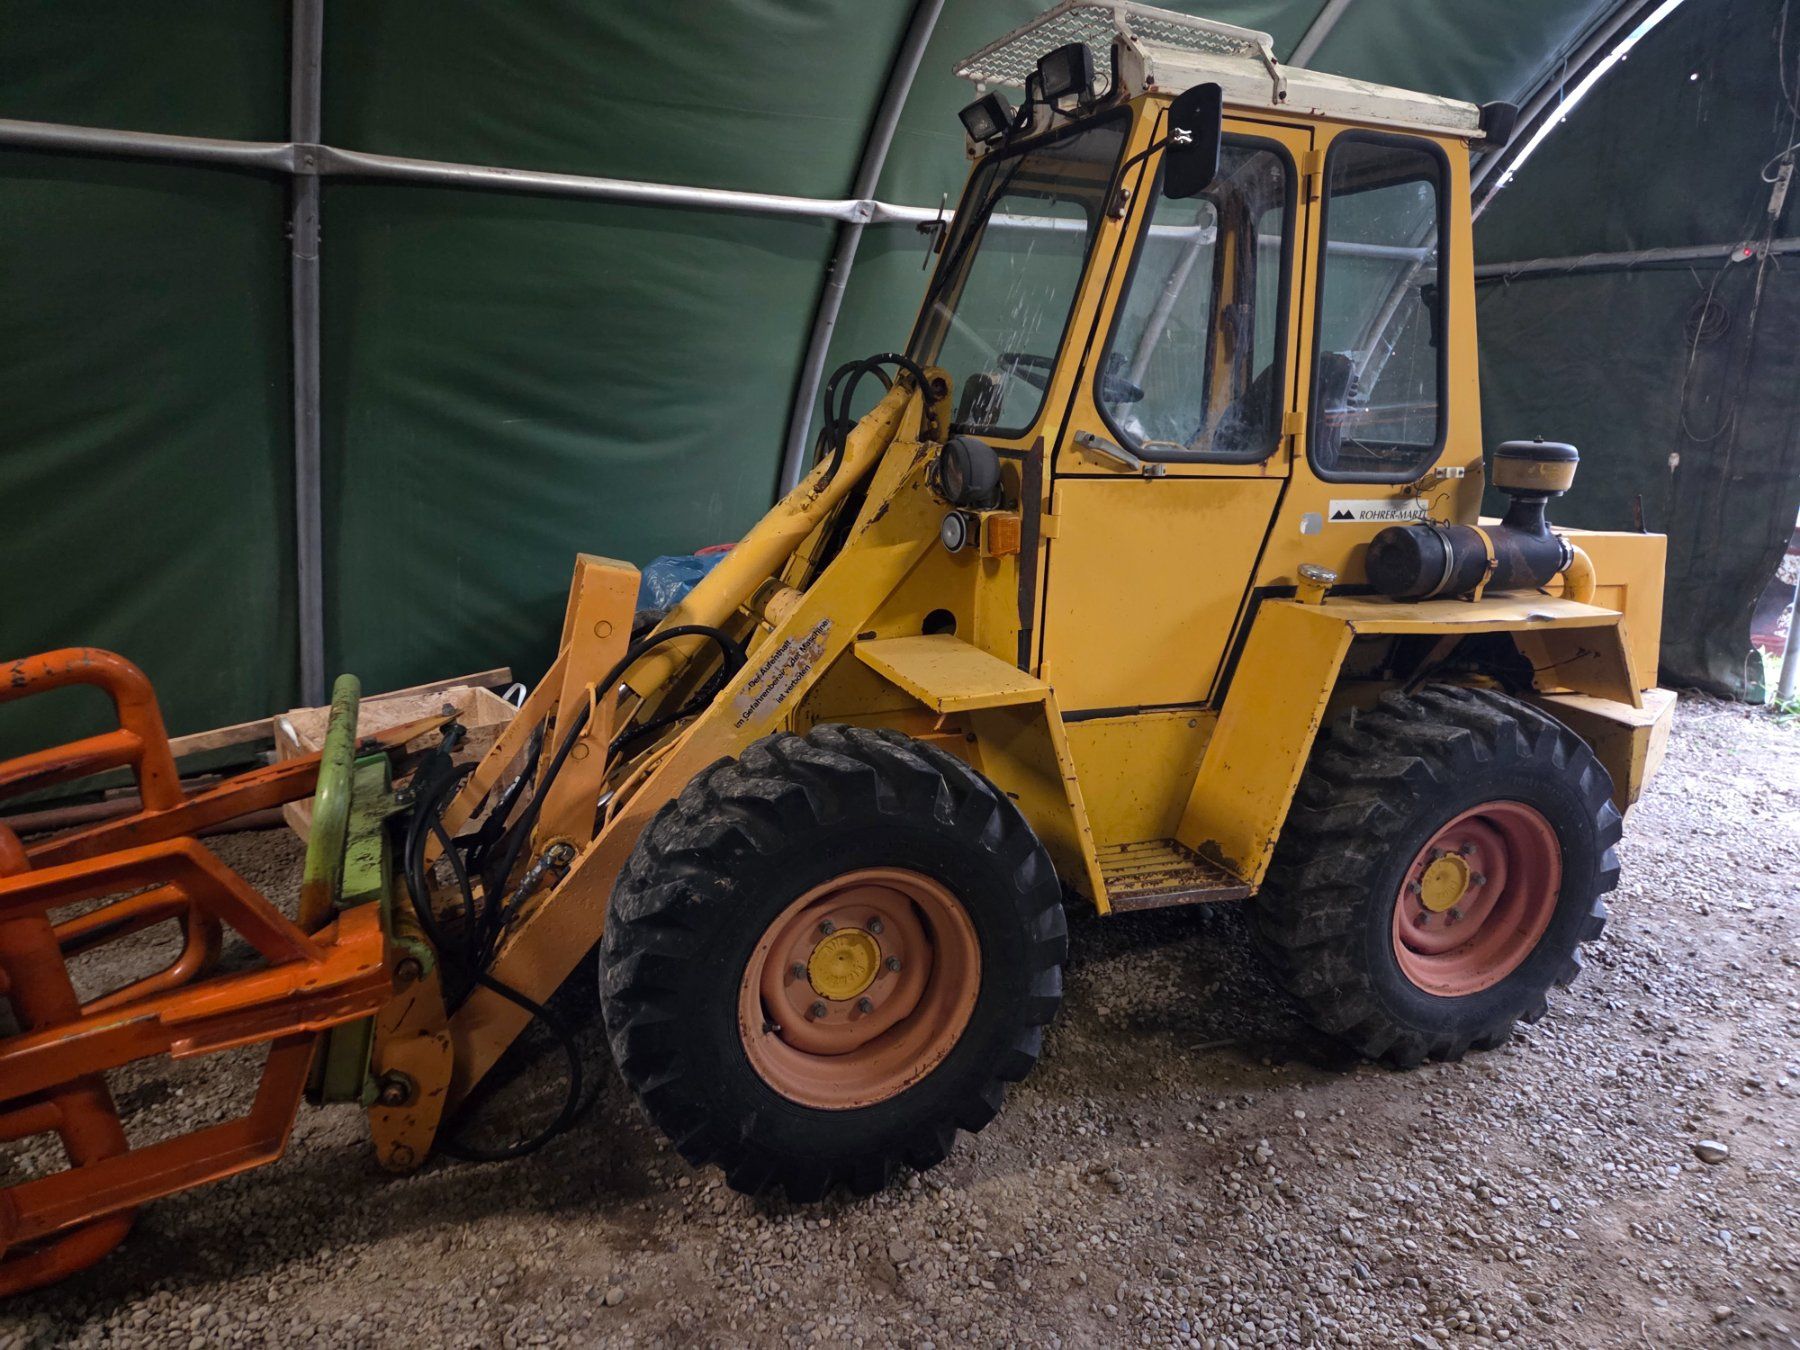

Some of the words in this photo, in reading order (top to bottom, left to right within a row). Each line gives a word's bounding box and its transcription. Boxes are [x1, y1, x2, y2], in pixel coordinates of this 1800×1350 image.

[734, 718, 745, 728] im
[789, 652, 802, 667] der
[799, 618, 829, 653] Maschine
[748, 675, 761, 688] Der
[760, 639, 792, 676] Aufenthalt
[775, 693, 786, 704] ist
[785, 664, 811, 694] verboten
